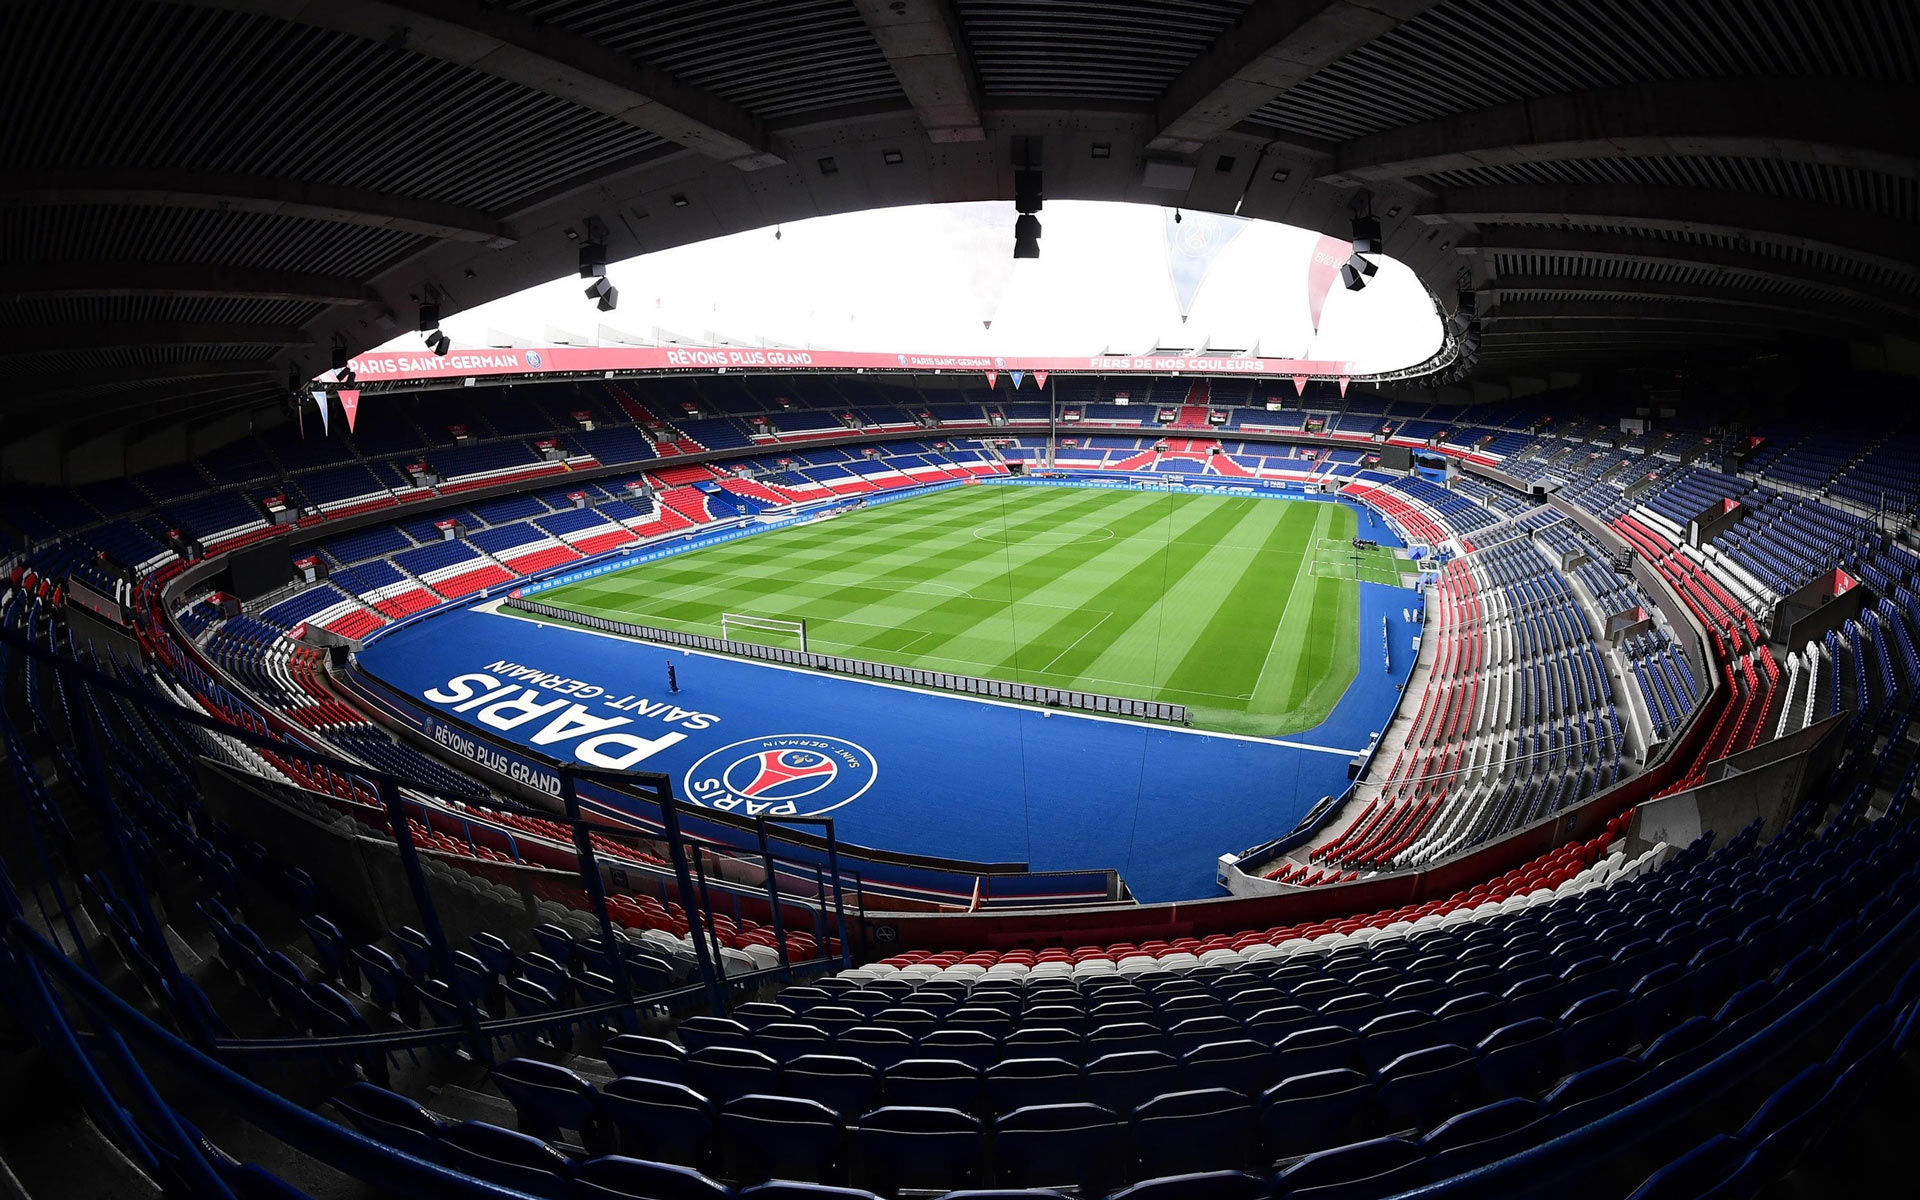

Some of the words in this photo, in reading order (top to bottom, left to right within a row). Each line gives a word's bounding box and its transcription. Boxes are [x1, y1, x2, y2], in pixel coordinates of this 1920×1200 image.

[347, 358, 397, 374] PARIS
[397, 354, 519, 372] SAINT-GERMAIN
[667, 348, 728, 365] RÊVONS
[729, 351, 764, 365] PLUS
[767, 352, 812, 365] GRAND
[911, 357, 934, 366] PARIS
[934, 357, 991, 367] SAINT-GERMAIN
[1090, 358, 1130, 369] FIERS
[1134, 359, 1151, 369] DE
[1155, 359, 1185, 370] NOS
[1189, 360, 1265, 371] COULEURS
[483, 660, 721, 730] SAINT-GERMAIN
[423, 673, 689, 770] PARIS
[435, 725, 475, 758] RÊVONS
[477, 746, 508, 773] PLUS
[510, 762, 561, 796] GRAND
[694, 778, 798, 815] PARIS
